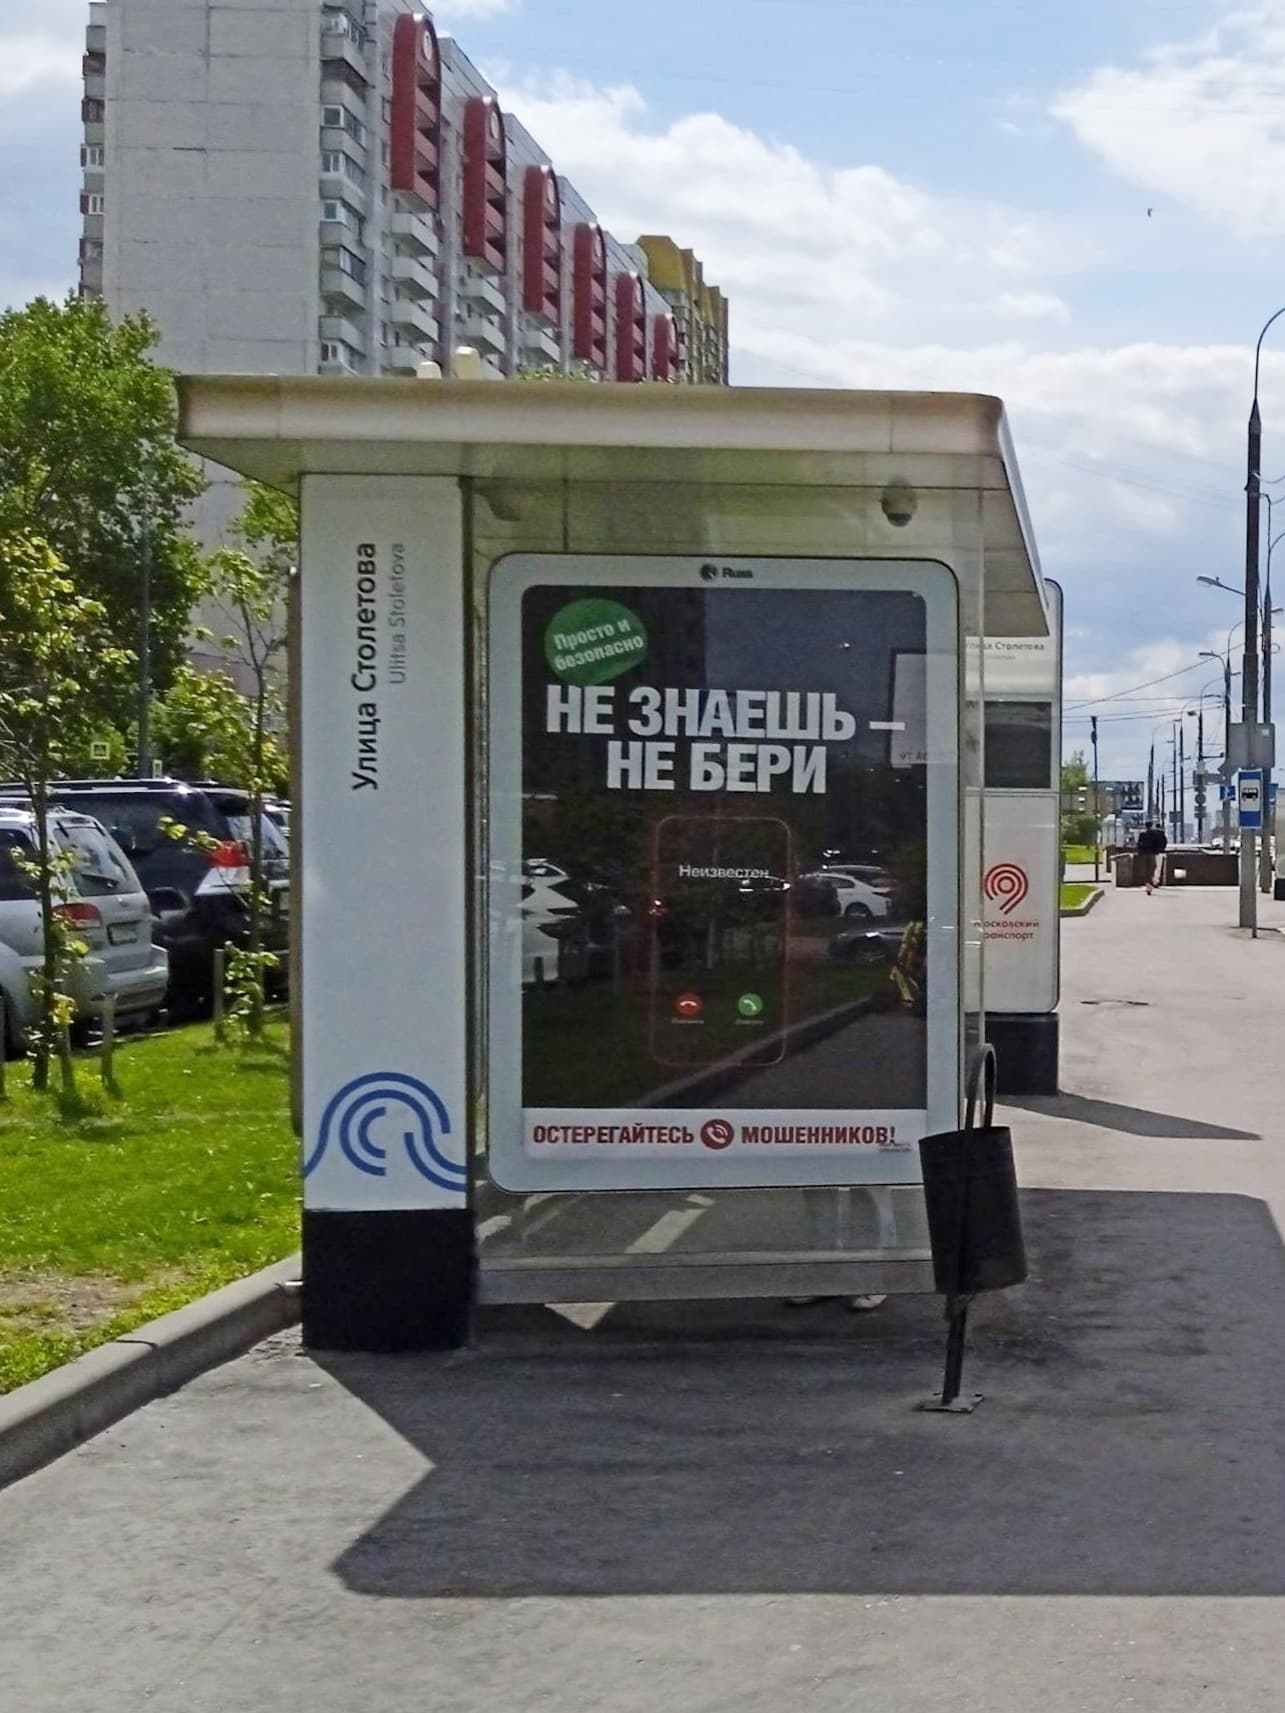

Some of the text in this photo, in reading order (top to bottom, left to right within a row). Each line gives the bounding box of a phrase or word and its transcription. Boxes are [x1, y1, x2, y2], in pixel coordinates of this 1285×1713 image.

[388, 543, 406, 684] Ulitsa Stoletova
[553, 618, 631, 651] Просто и
[351, 543, 381, 790] Улица Столетова
[554, 635, 644, 671] безопасно
[546, 684, 615, 734] НЕ
[627, 686, 857, 740] ЗНАЕШЬ
[606, 740, 827, 794] НЕ БЕРИ
[679, 864, 769, 878] Неизвестен
[533, 1122, 896, 1145] ОСТЕРЕГАЙТЕСЬ МОШЕННИКОВ!
